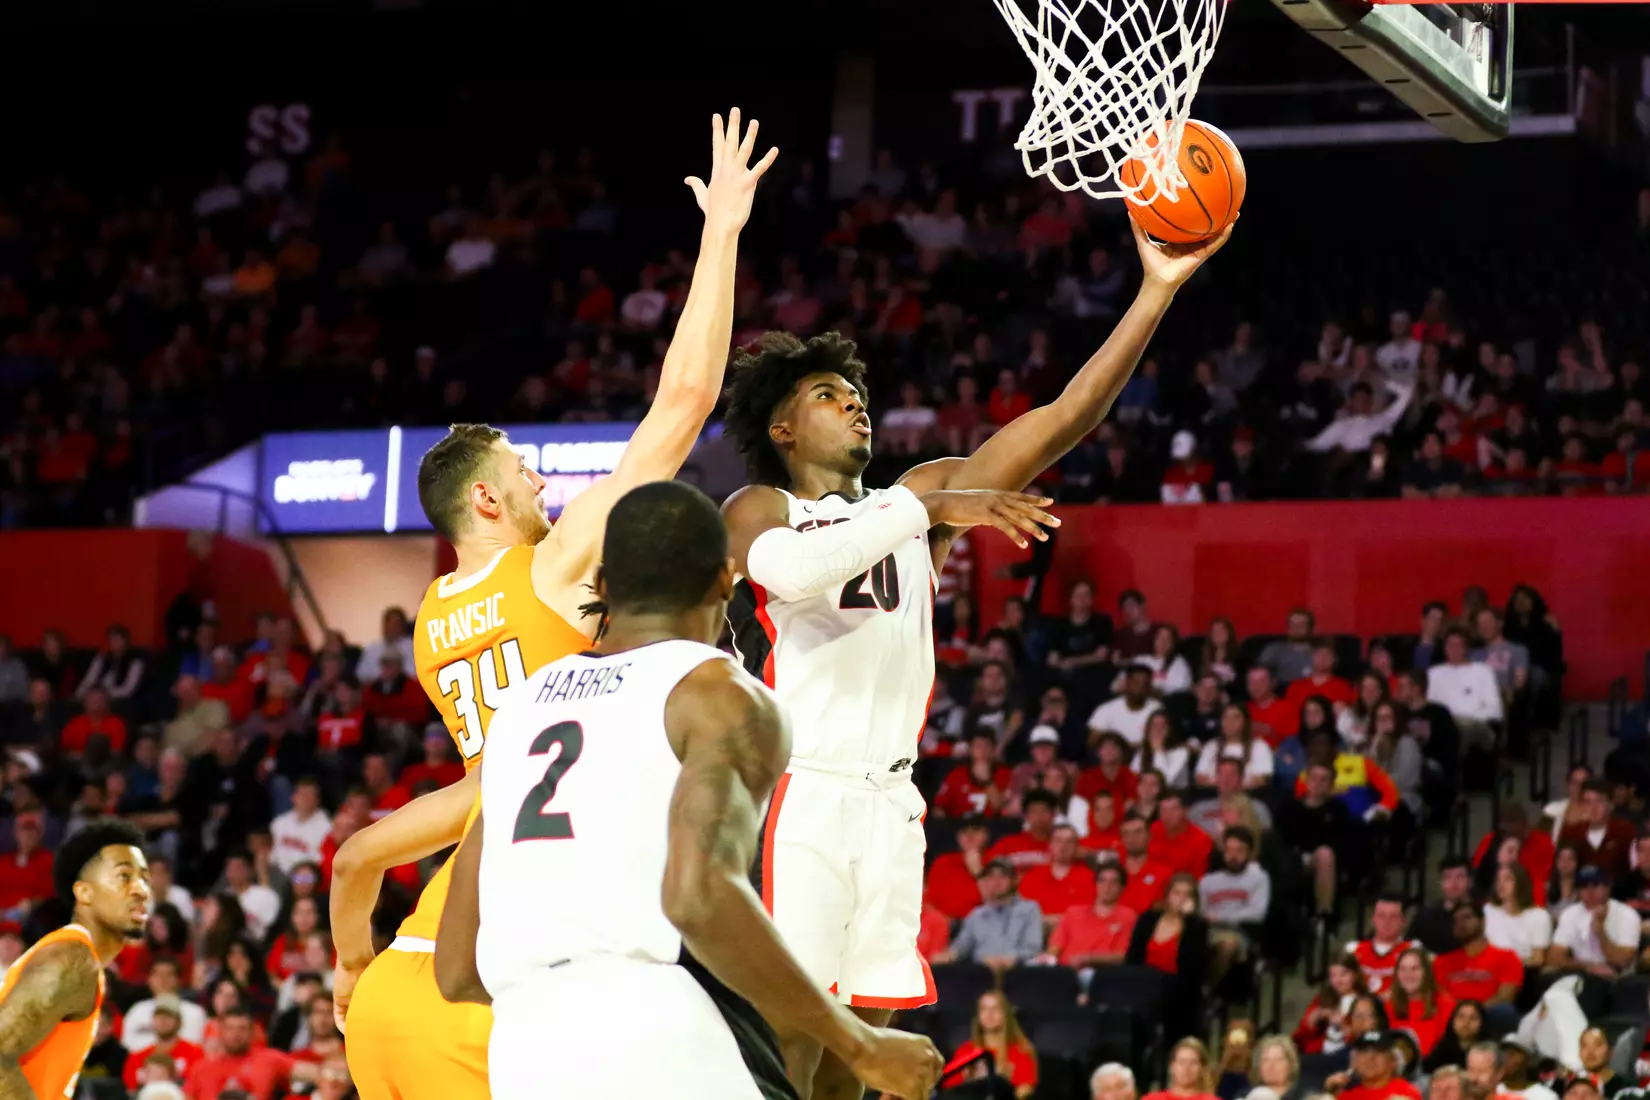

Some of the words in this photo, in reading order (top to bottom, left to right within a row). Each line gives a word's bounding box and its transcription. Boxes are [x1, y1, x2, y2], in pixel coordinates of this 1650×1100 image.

[839, 552, 900, 613] 20
[427, 592, 505, 653] PLAVSIC
[436, 637, 528, 760] 34
[535, 662, 632, 703] HARRIS
[512, 720, 584, 844] 2
